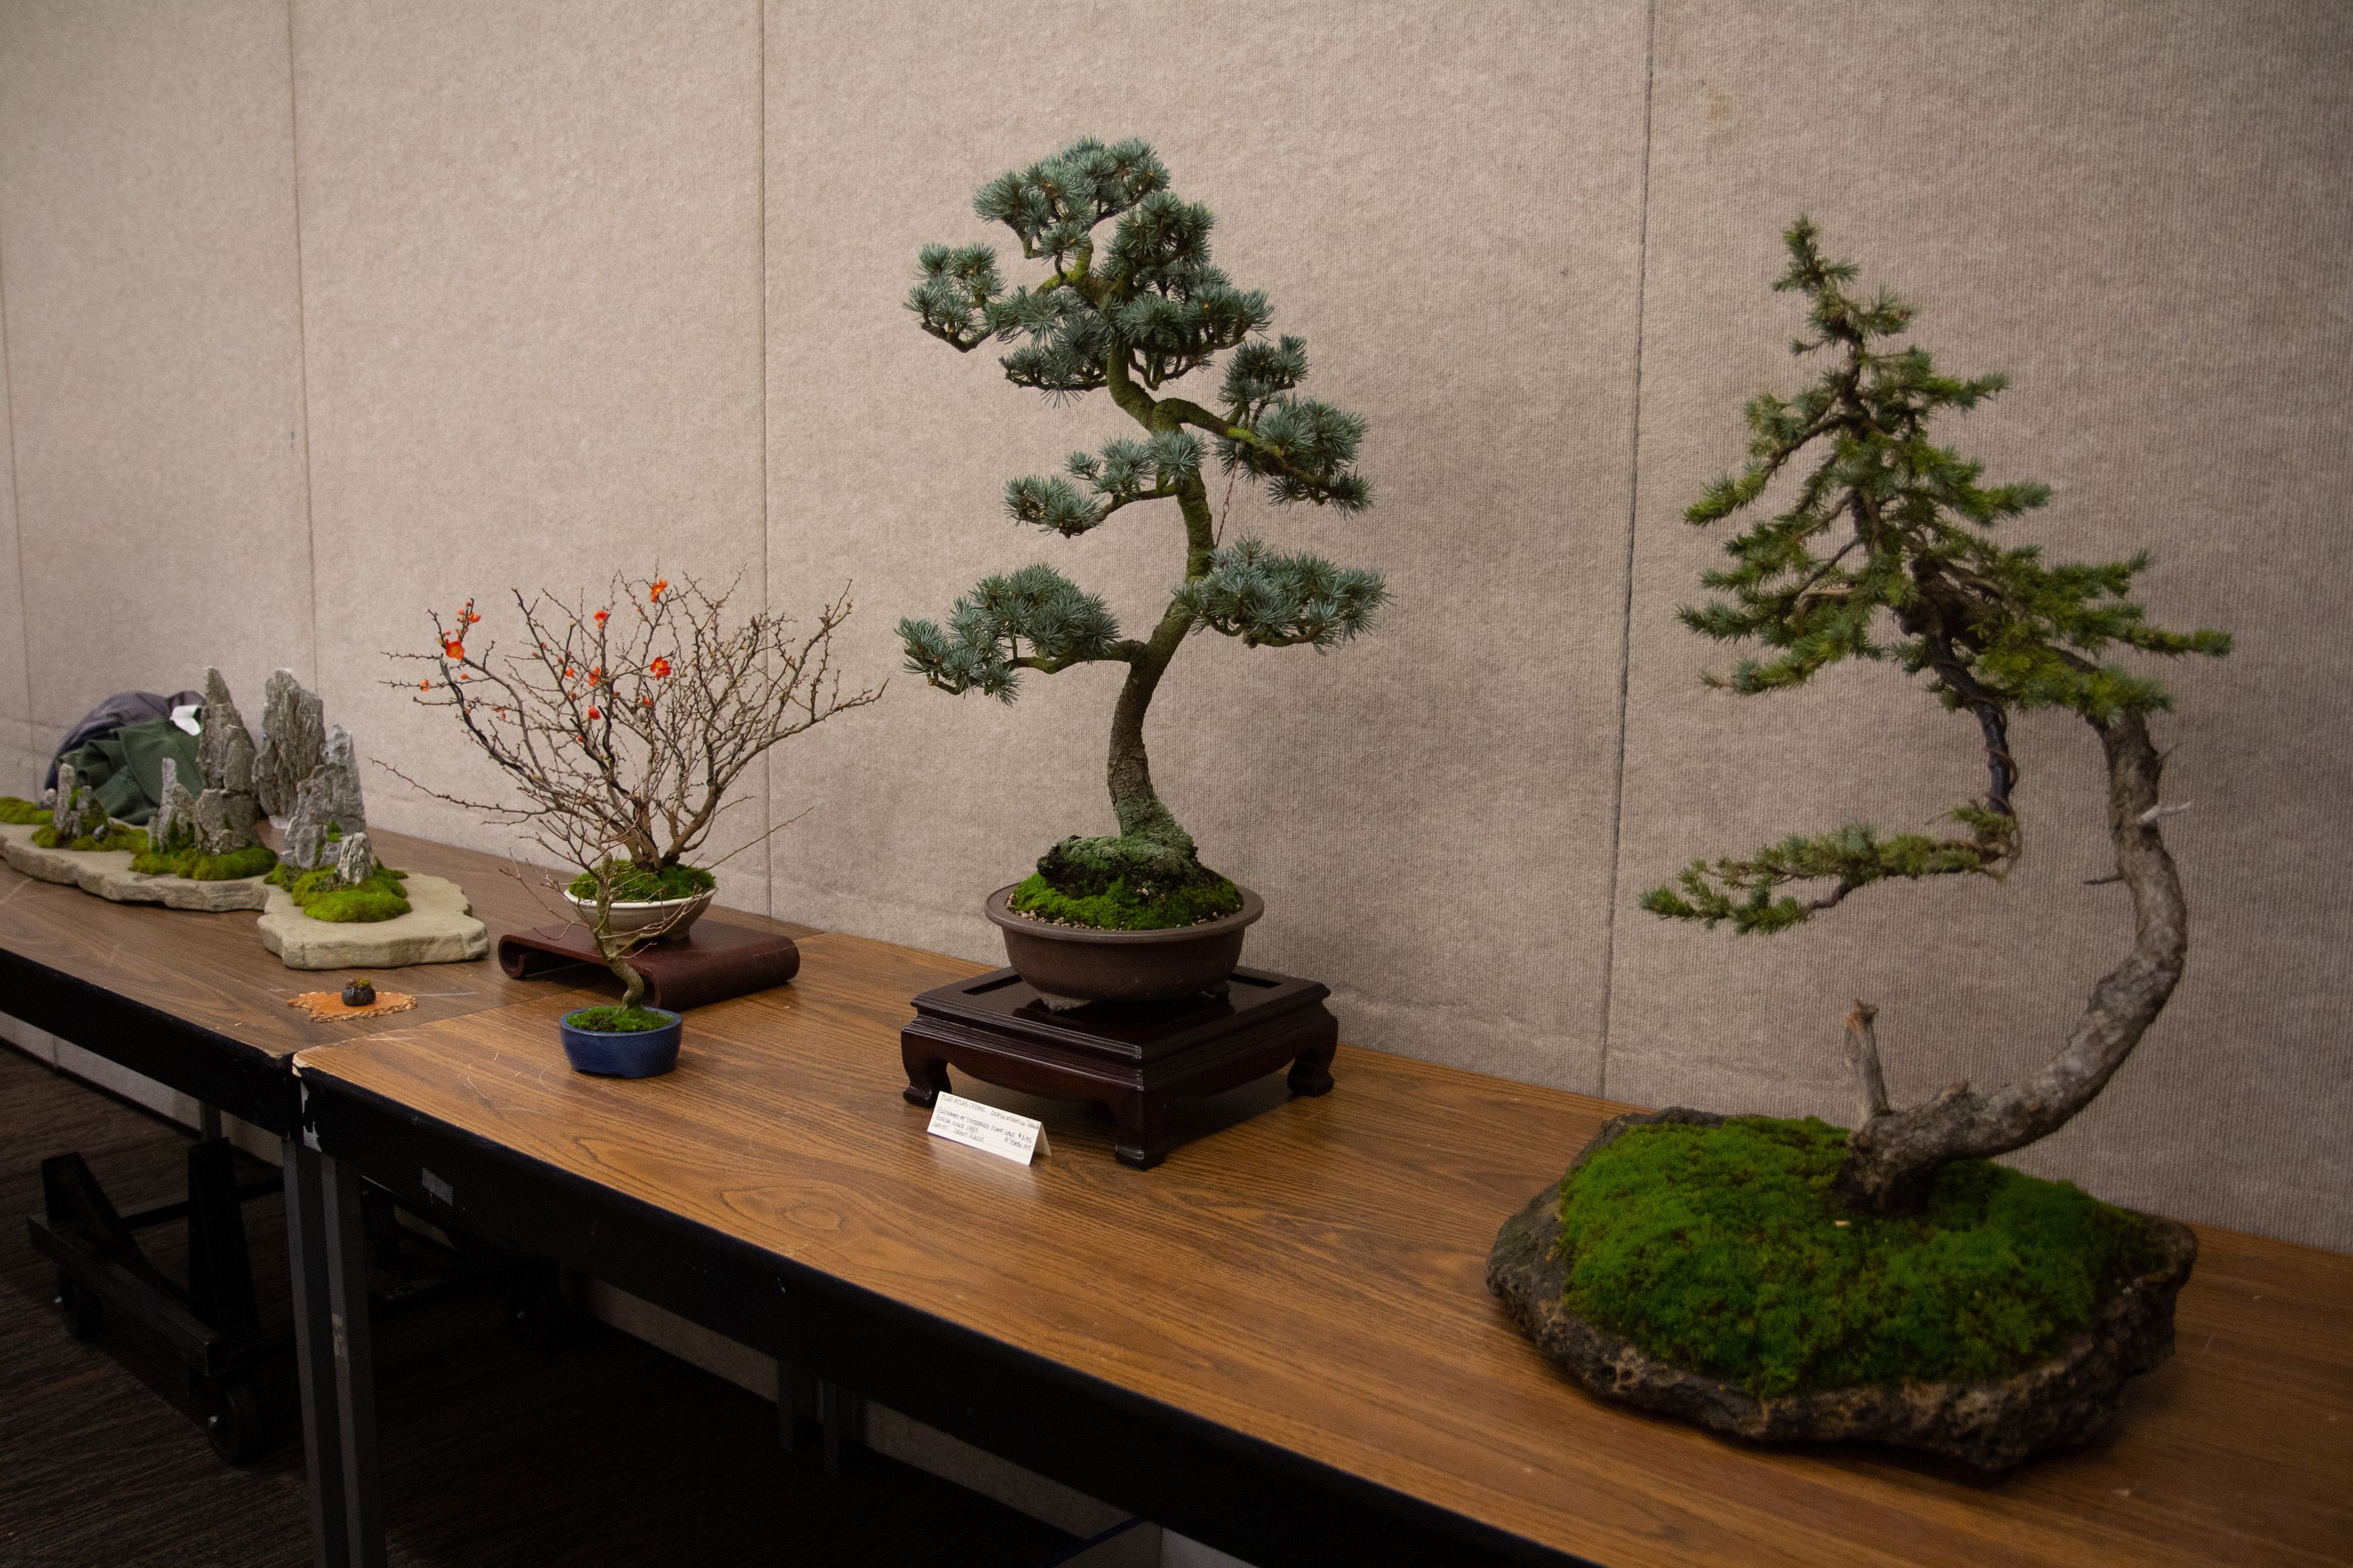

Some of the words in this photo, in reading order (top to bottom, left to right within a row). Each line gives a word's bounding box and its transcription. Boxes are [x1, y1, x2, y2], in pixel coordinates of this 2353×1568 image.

[941, 1094, 953, 1102] BLUE
[954, 1097, 969, 1107] ATLAS
[969, 1102, 986, 1112] CEDAR
[936, 1114, 951, 1123] BONSAI
[952, 1120, 965, 1128] SINCE
[953, 1128, 968, 1137] GRANT
[991, 1124, 1004, 1133] PLANT
[1004, 1129, 1014, 1137] SALE
